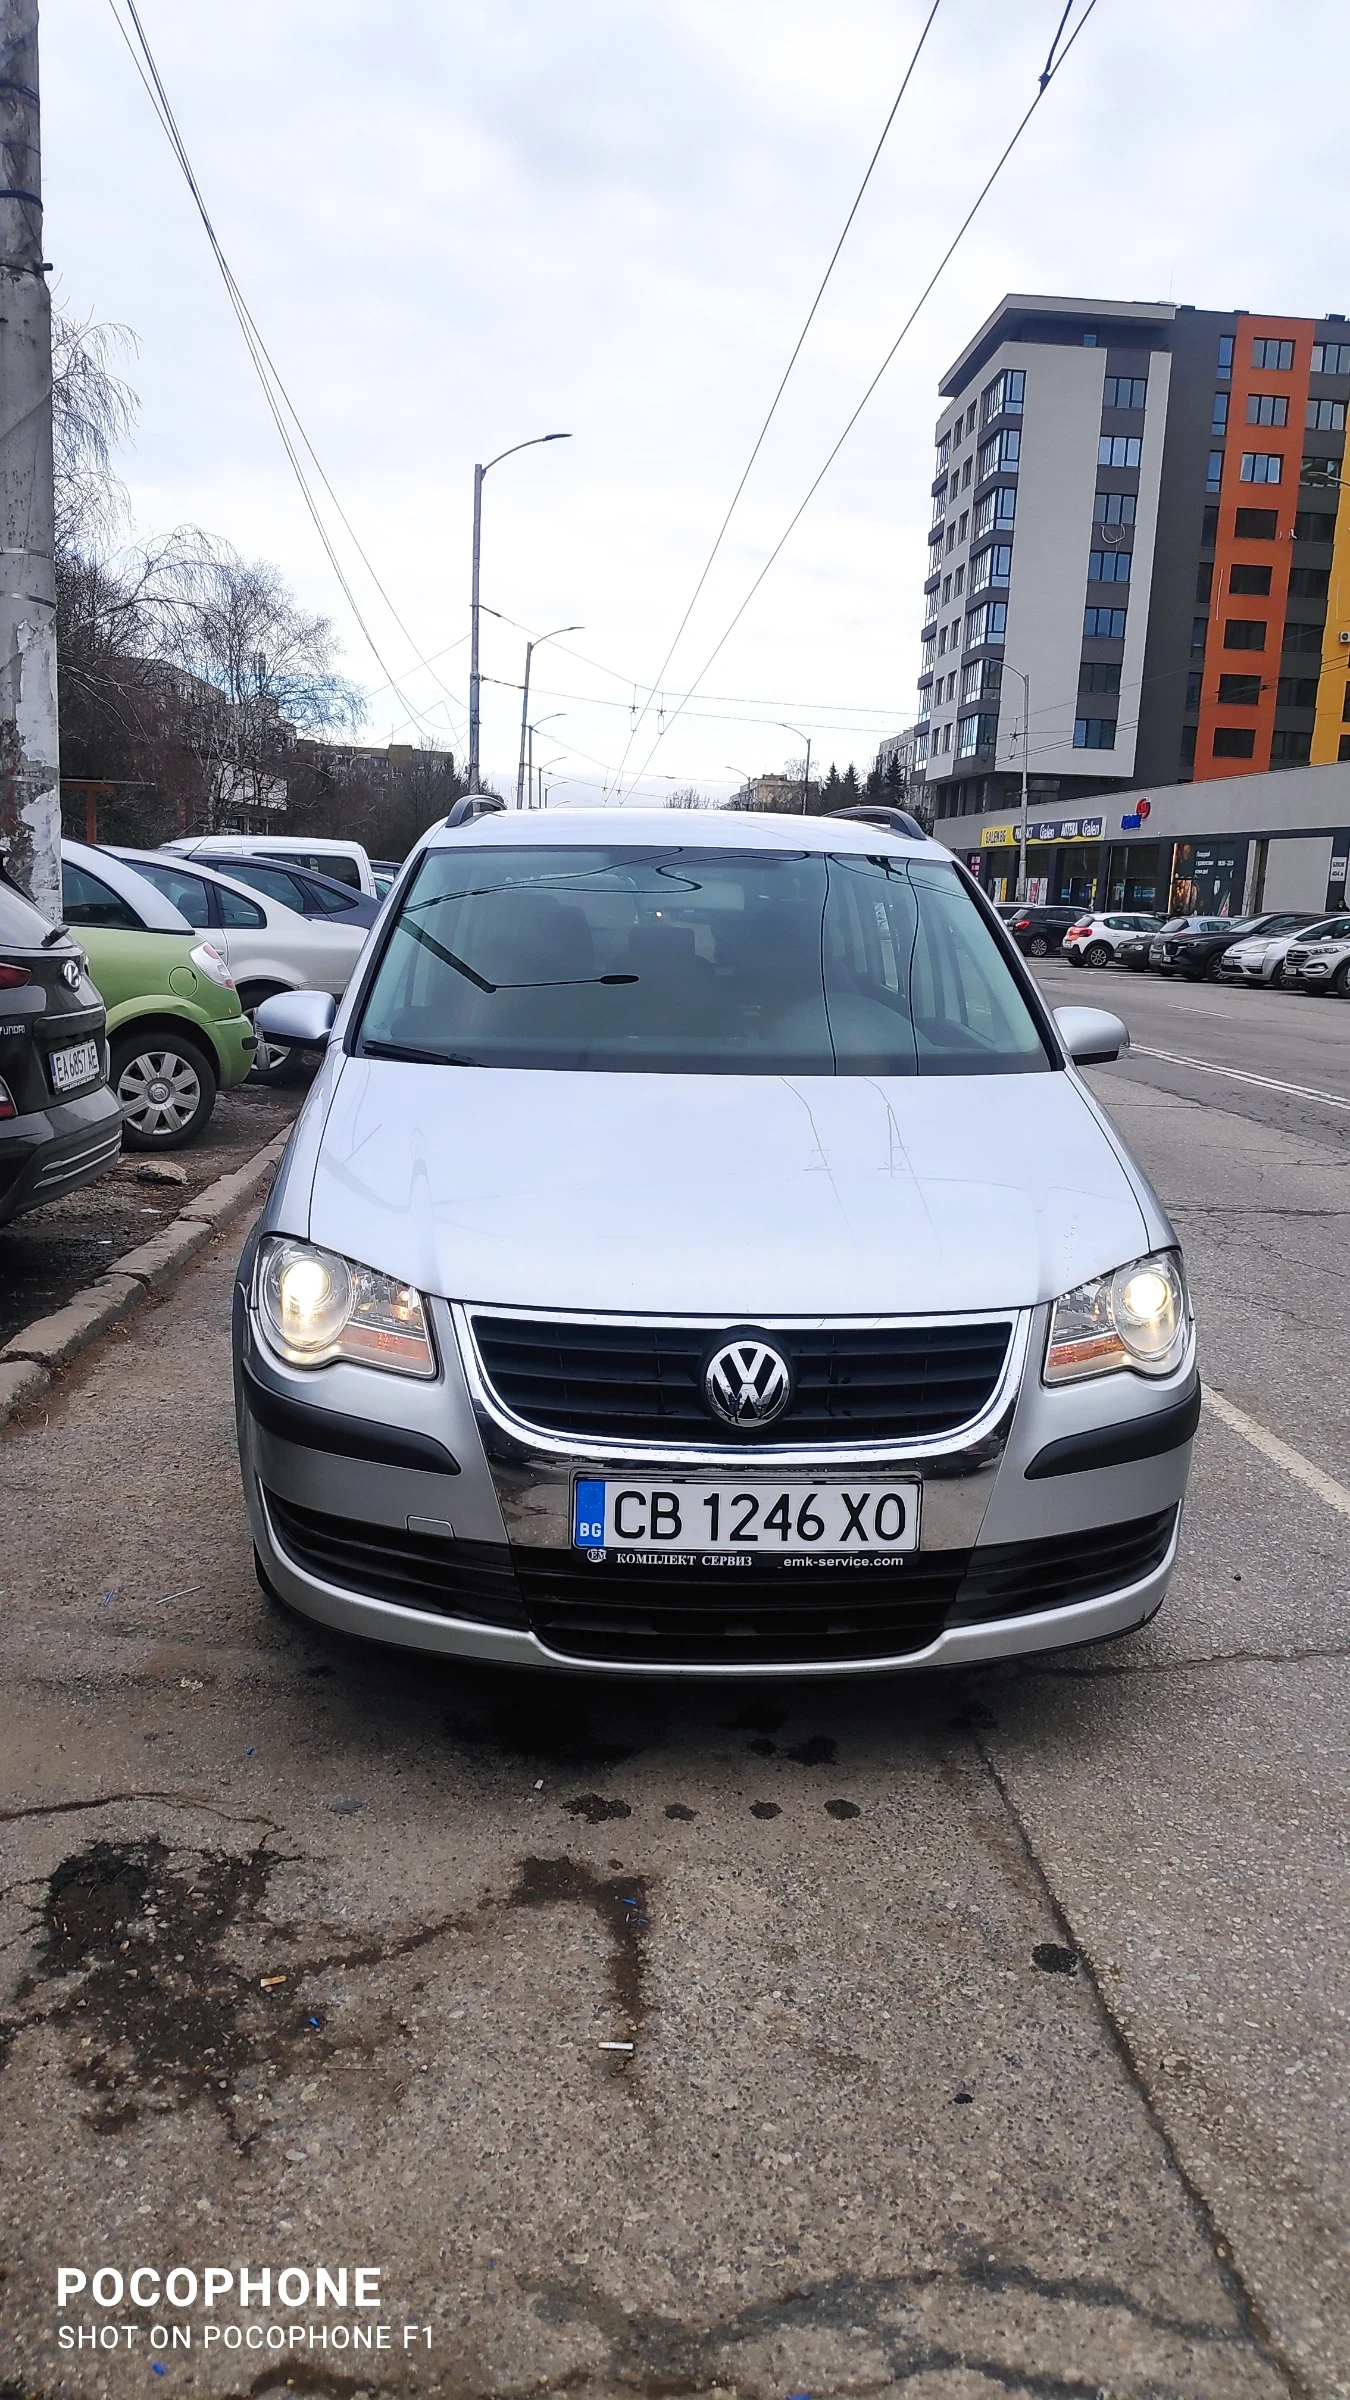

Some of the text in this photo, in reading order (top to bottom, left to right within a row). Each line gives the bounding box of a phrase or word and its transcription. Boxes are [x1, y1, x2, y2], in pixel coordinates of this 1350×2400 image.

[1039, 823, 1055, 840] Galen
[1081, 819, 1100, 837] Galen
[56, 1045, 97, 1081] EA 6857 AE
[613, 1490, 907, 1542] CB 1246 XO
[579, 1522, 602, 1538] BG
[616, 1552, 753, 1567] КОМПЛЕКТ СЕРВИЗ
[783, 1555, 904, 1568] emk-service.com
